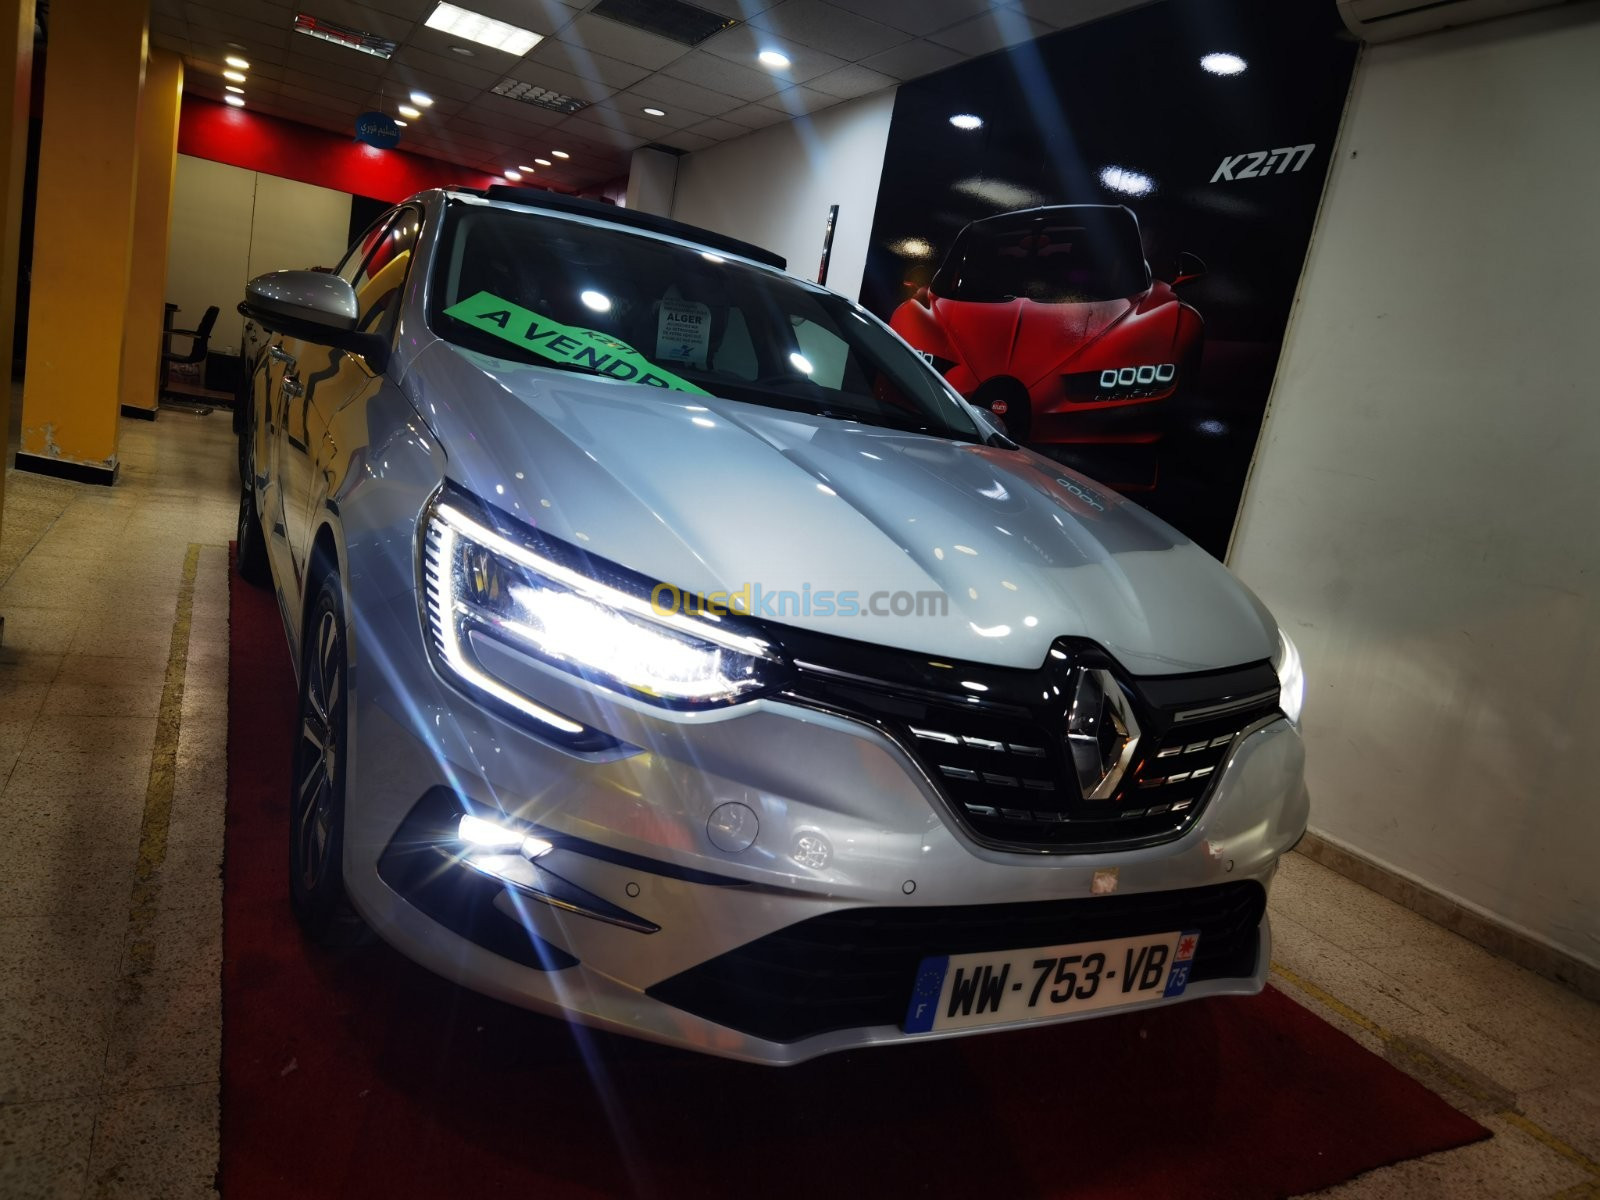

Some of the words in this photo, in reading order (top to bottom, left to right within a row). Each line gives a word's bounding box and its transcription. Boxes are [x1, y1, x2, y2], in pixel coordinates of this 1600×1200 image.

[667, 312, 702, 325] ALGER
[476, 309, 512, 329] A
[524, 322, 685, 391] VENDR
[916, 1003, 927, 1018] F
[1169, 967, 1188, 988] 75
